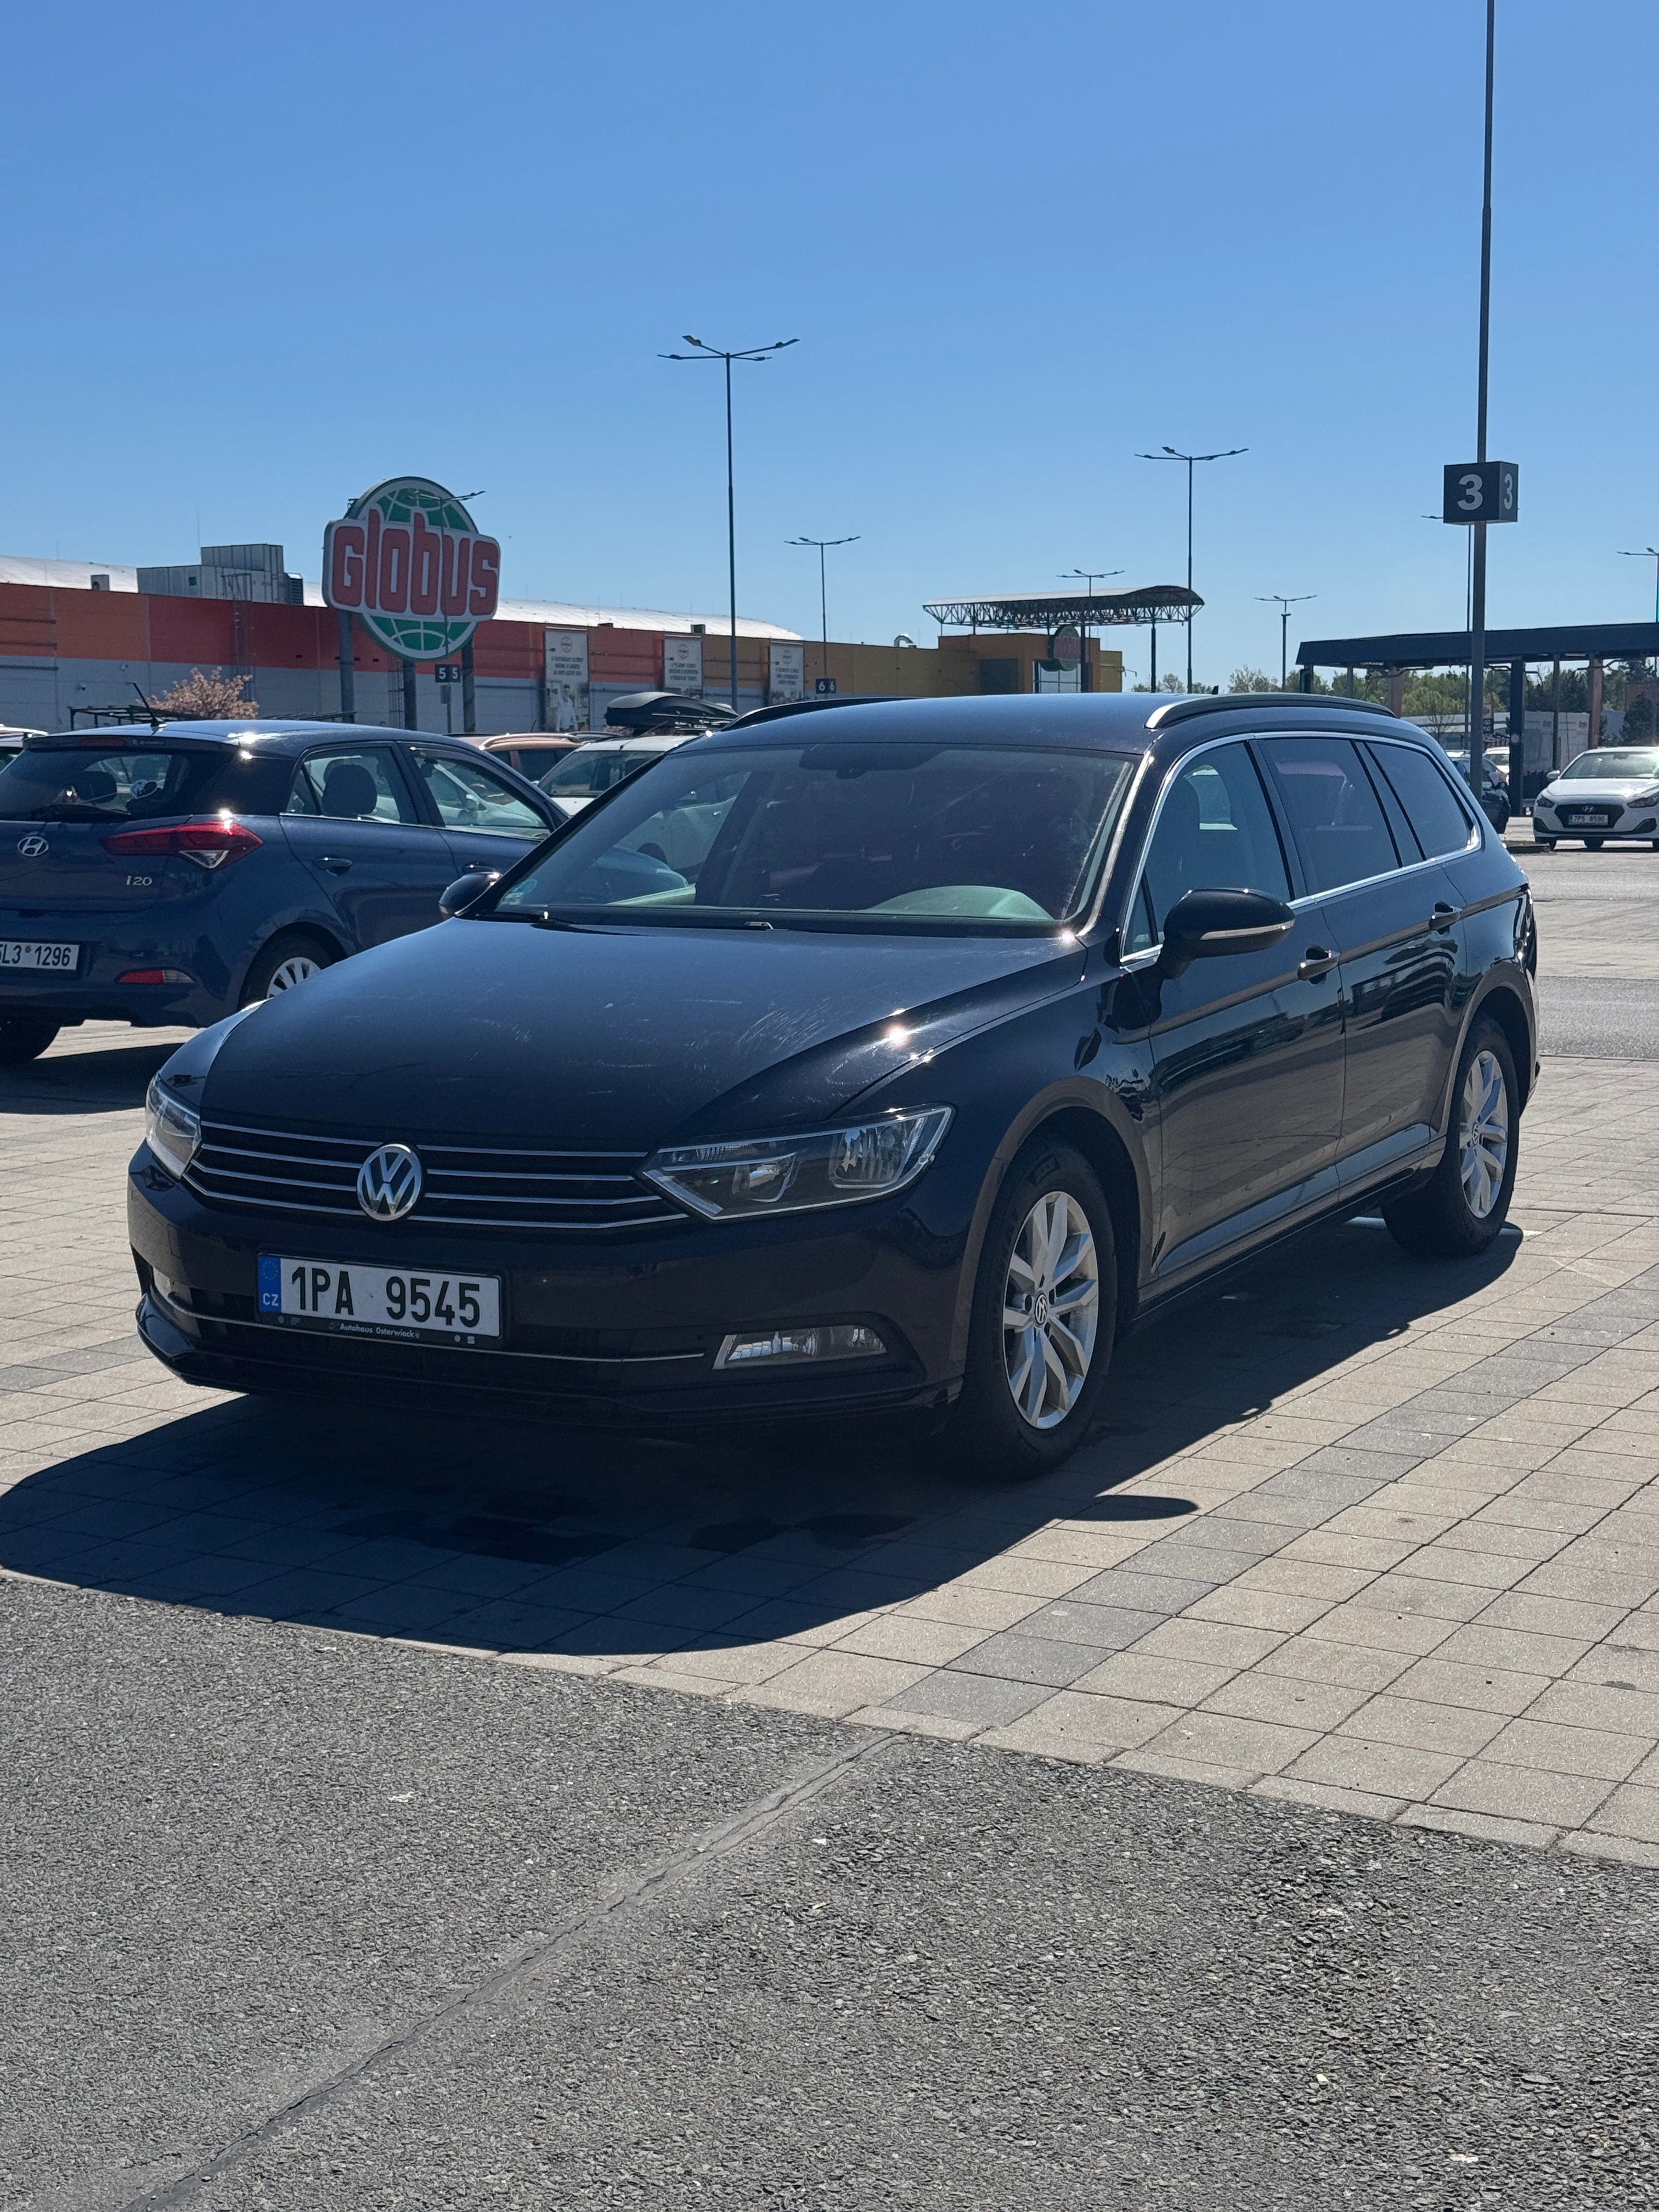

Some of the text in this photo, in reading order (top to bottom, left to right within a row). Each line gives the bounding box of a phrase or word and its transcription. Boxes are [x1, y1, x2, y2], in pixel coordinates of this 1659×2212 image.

[1457, 474, 1483, 511] 3
[1504, 473, 1513, 510] 3
[332, 509, 499, 616] Globus
[439, 667, 447, 680] 5
[452, 667, 458, 679] 5
[819, 681, 826, 691] 6
[830, 681, 834, 691] 6
[35, 946, 72, 967] 1296
[263, 1293, 279, 1306] CZ
[291, 1267, 480, 1328] 1PA 9545
[340, 1323, 414, 1338] Autohaus Osterwieck
